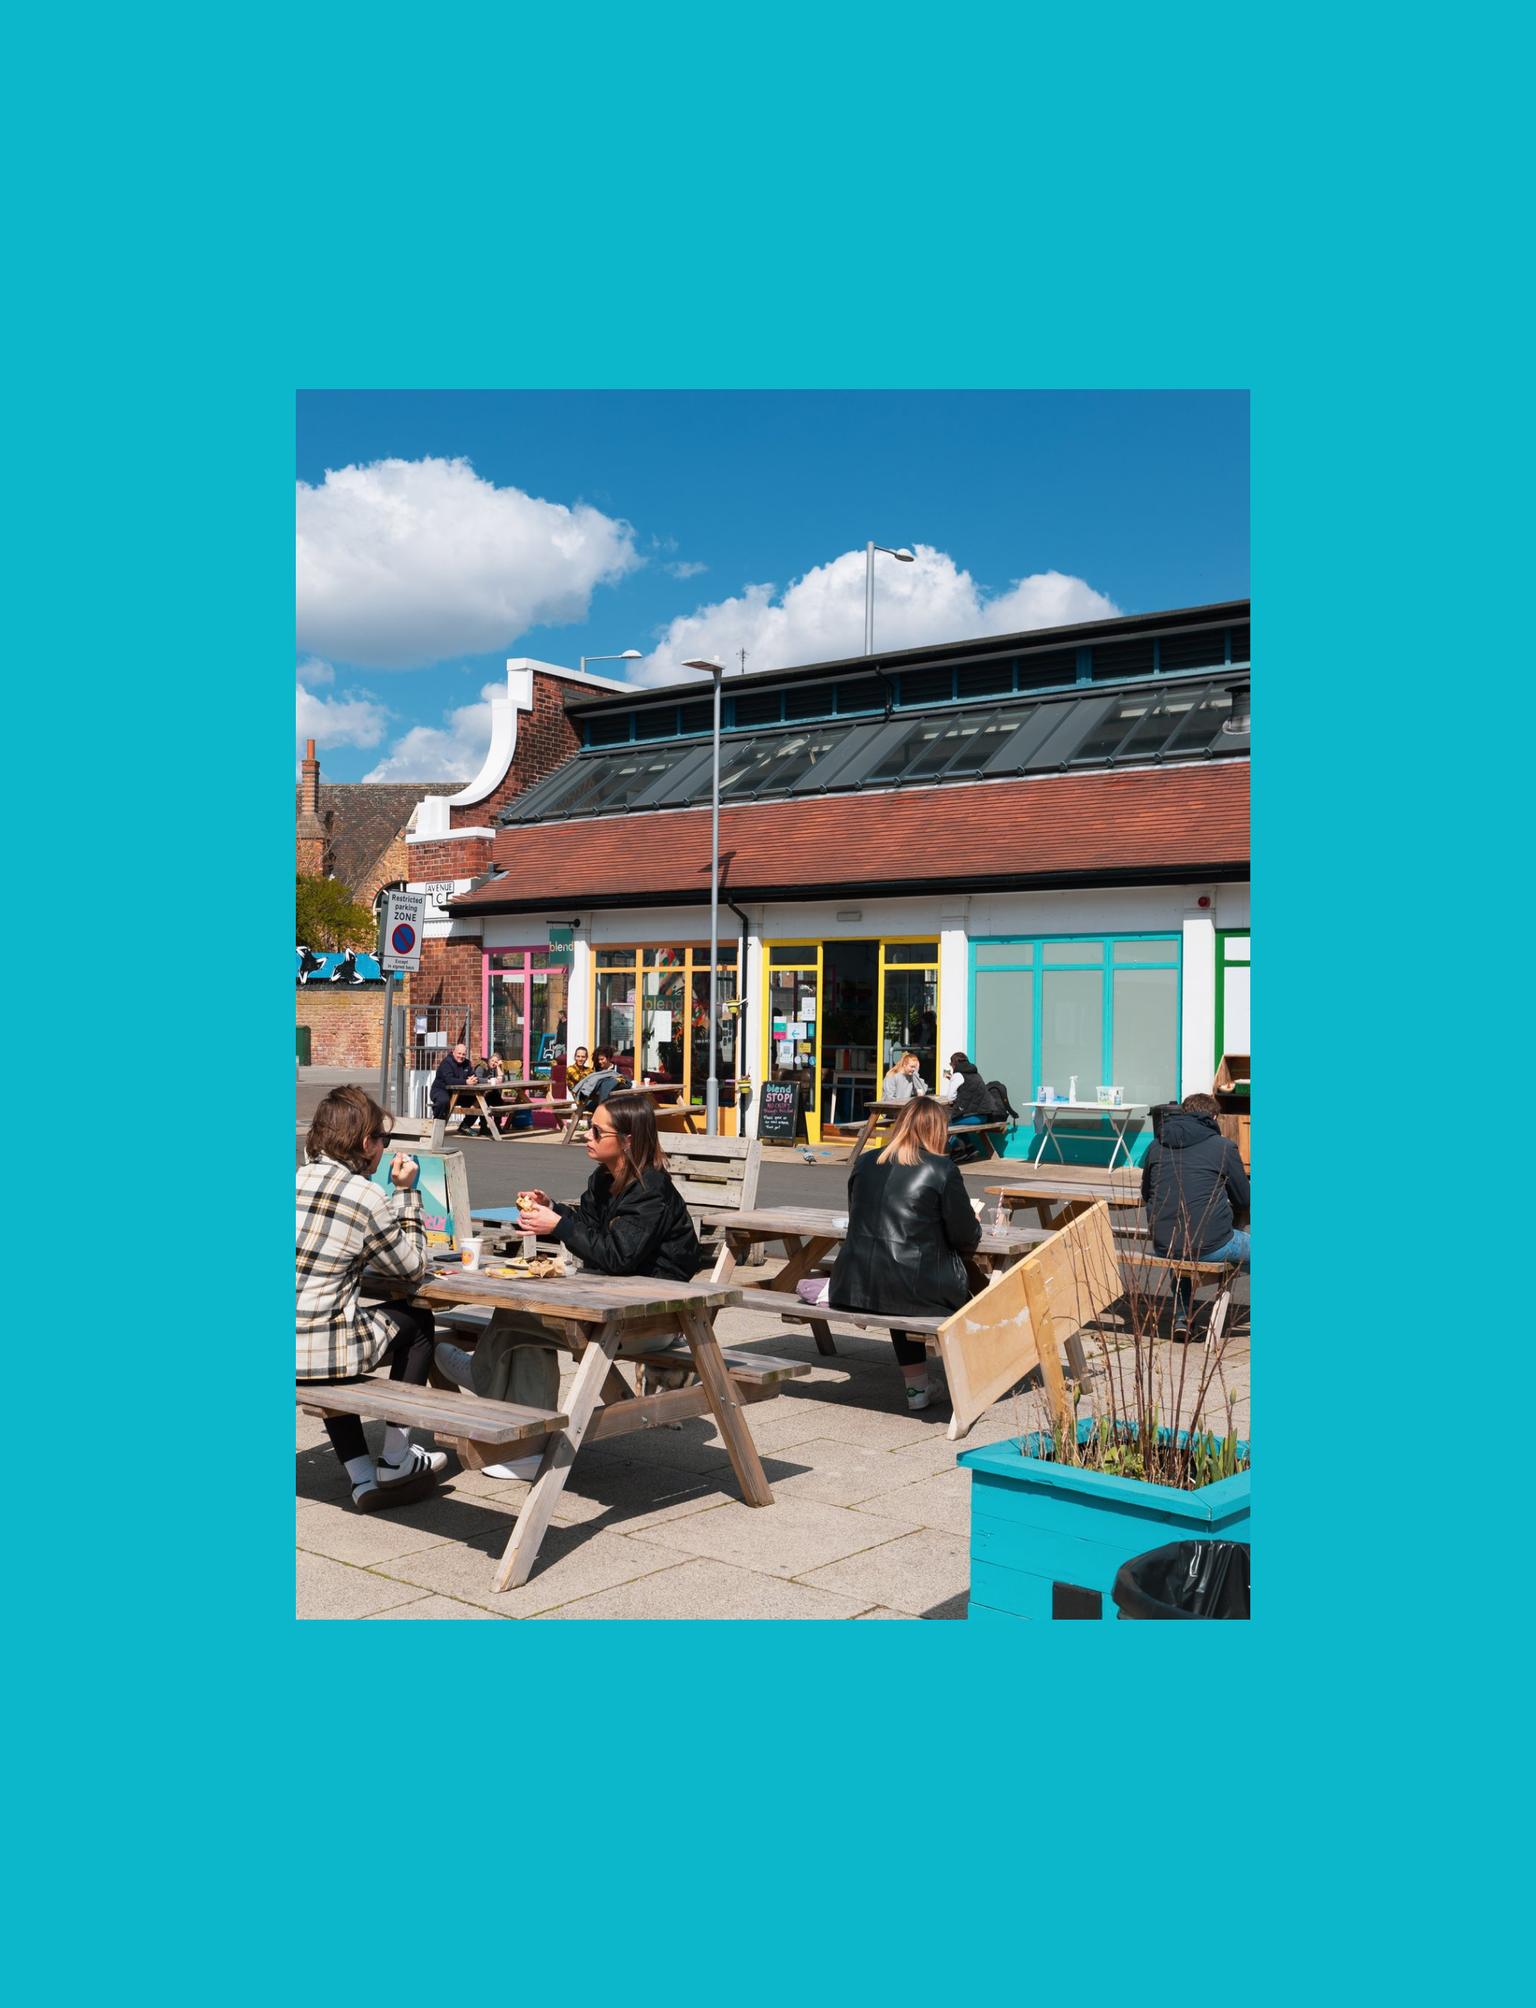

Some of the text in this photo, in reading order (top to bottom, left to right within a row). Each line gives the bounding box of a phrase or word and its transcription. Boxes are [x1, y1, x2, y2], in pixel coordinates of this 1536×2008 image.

[427, 883, 452, 892] AVENUE
[391, 894, 423, 904] Restricted
[436, 893, 444, 904] C
[394, 904, 418, 912] parking
[394, 912, 416, 922] ZONE
[550, 941, 574, 952] blend
[644, 995, 682, 1010] blend
[766, 1084, 792, 1093] blend
[766, 1092, 793, 1104] STOP!
